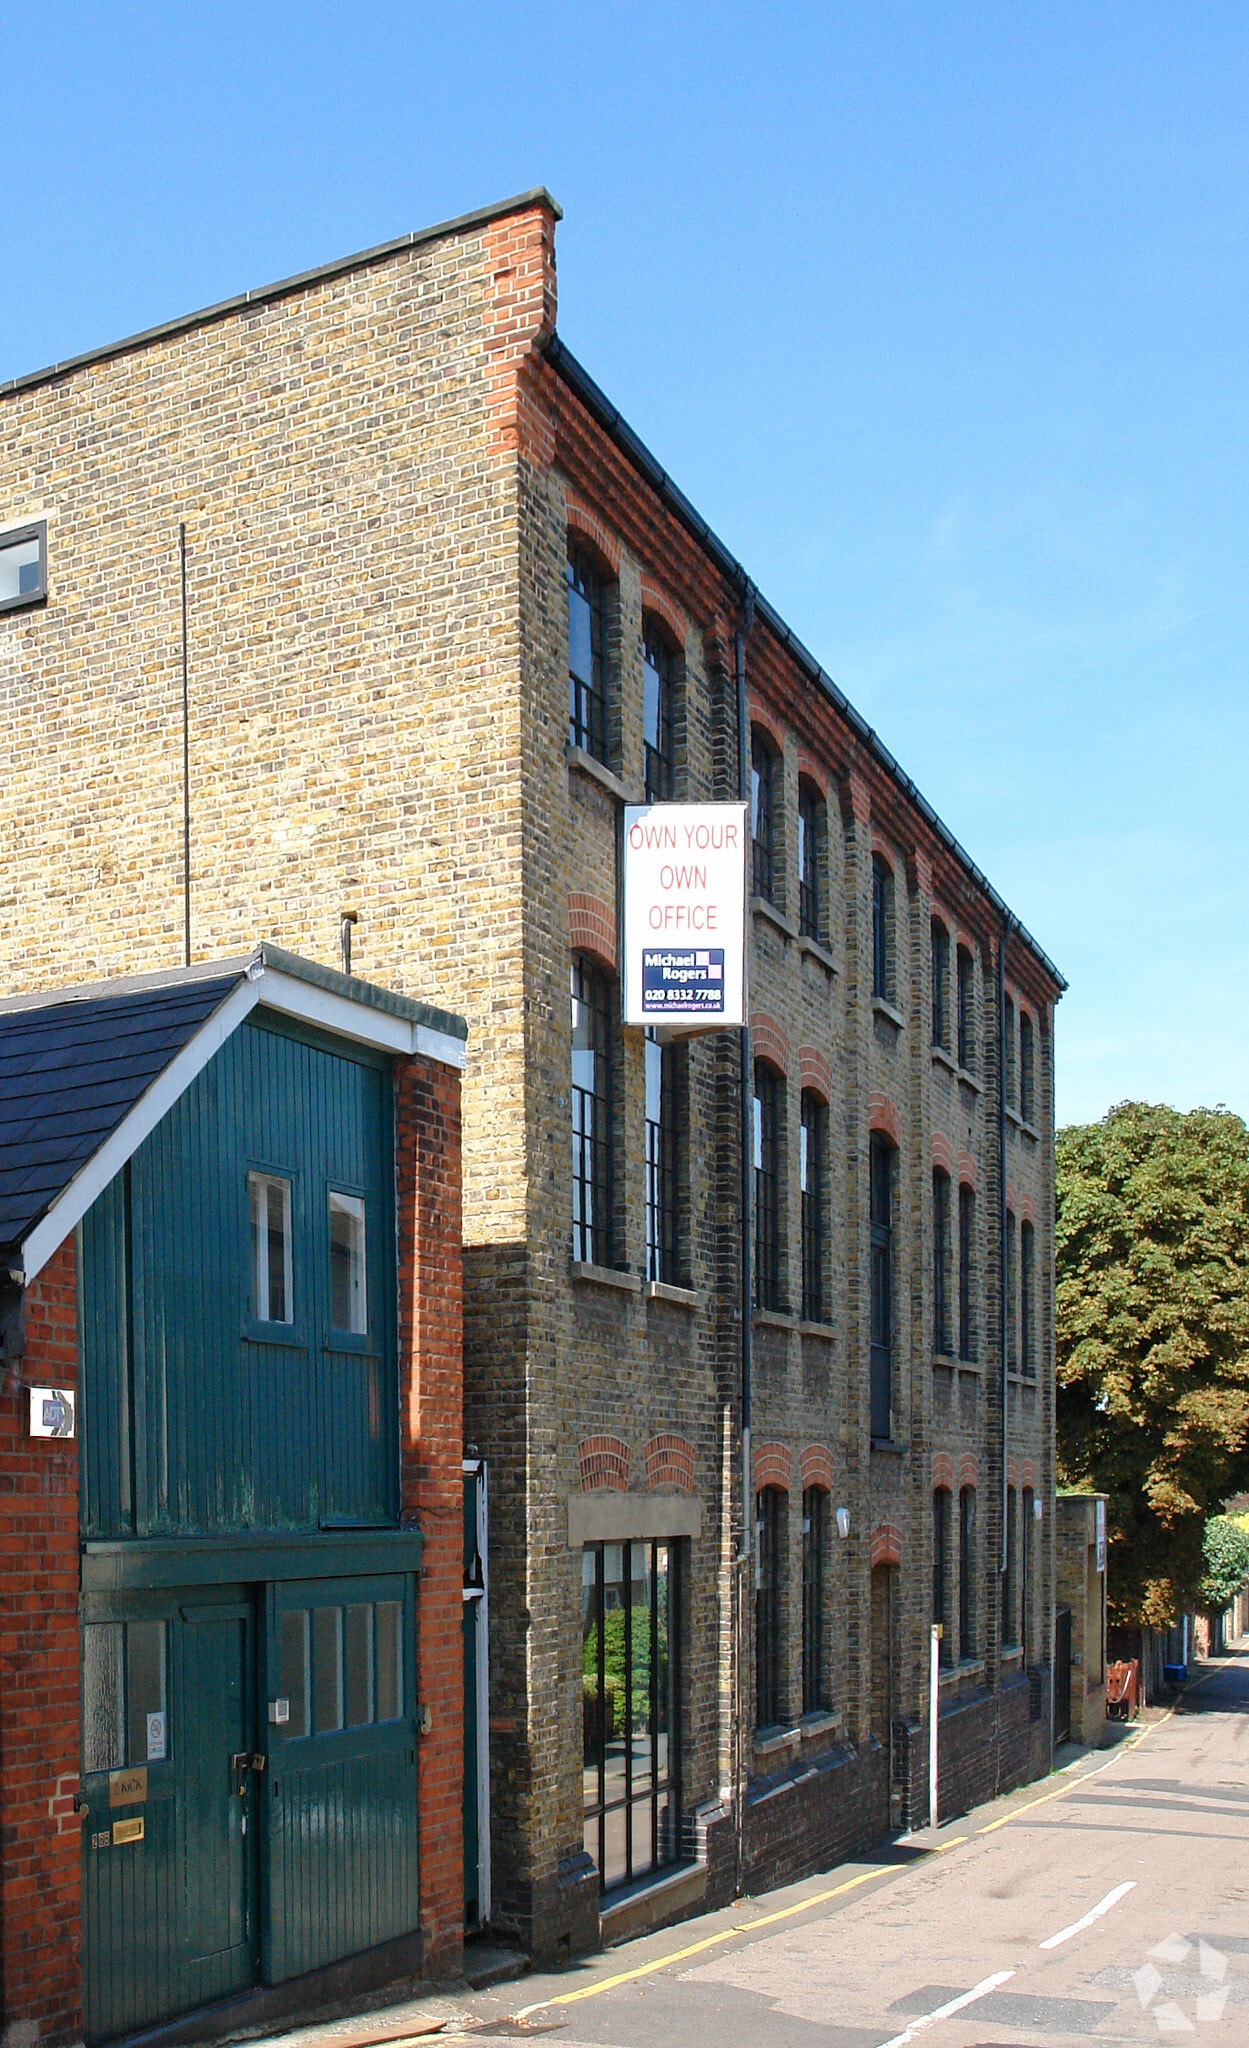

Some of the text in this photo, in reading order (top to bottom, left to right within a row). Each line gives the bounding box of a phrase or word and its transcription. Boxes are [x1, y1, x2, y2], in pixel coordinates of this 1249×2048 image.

[629, 824, 738, 850] OWN YOUR
[660, 865, 707, 890] OWN
[648, 905, 718, 930] OFFICE
[645, 953, 695, 967] Michael
[662, 967, 707, 983] Rogers
[645, 989, 722, 1000] 020 8332 7788
[645, 1001, 721, 1011] www.michaelrogers.co.uk
[44, 1406, 62, 1421] ADT
